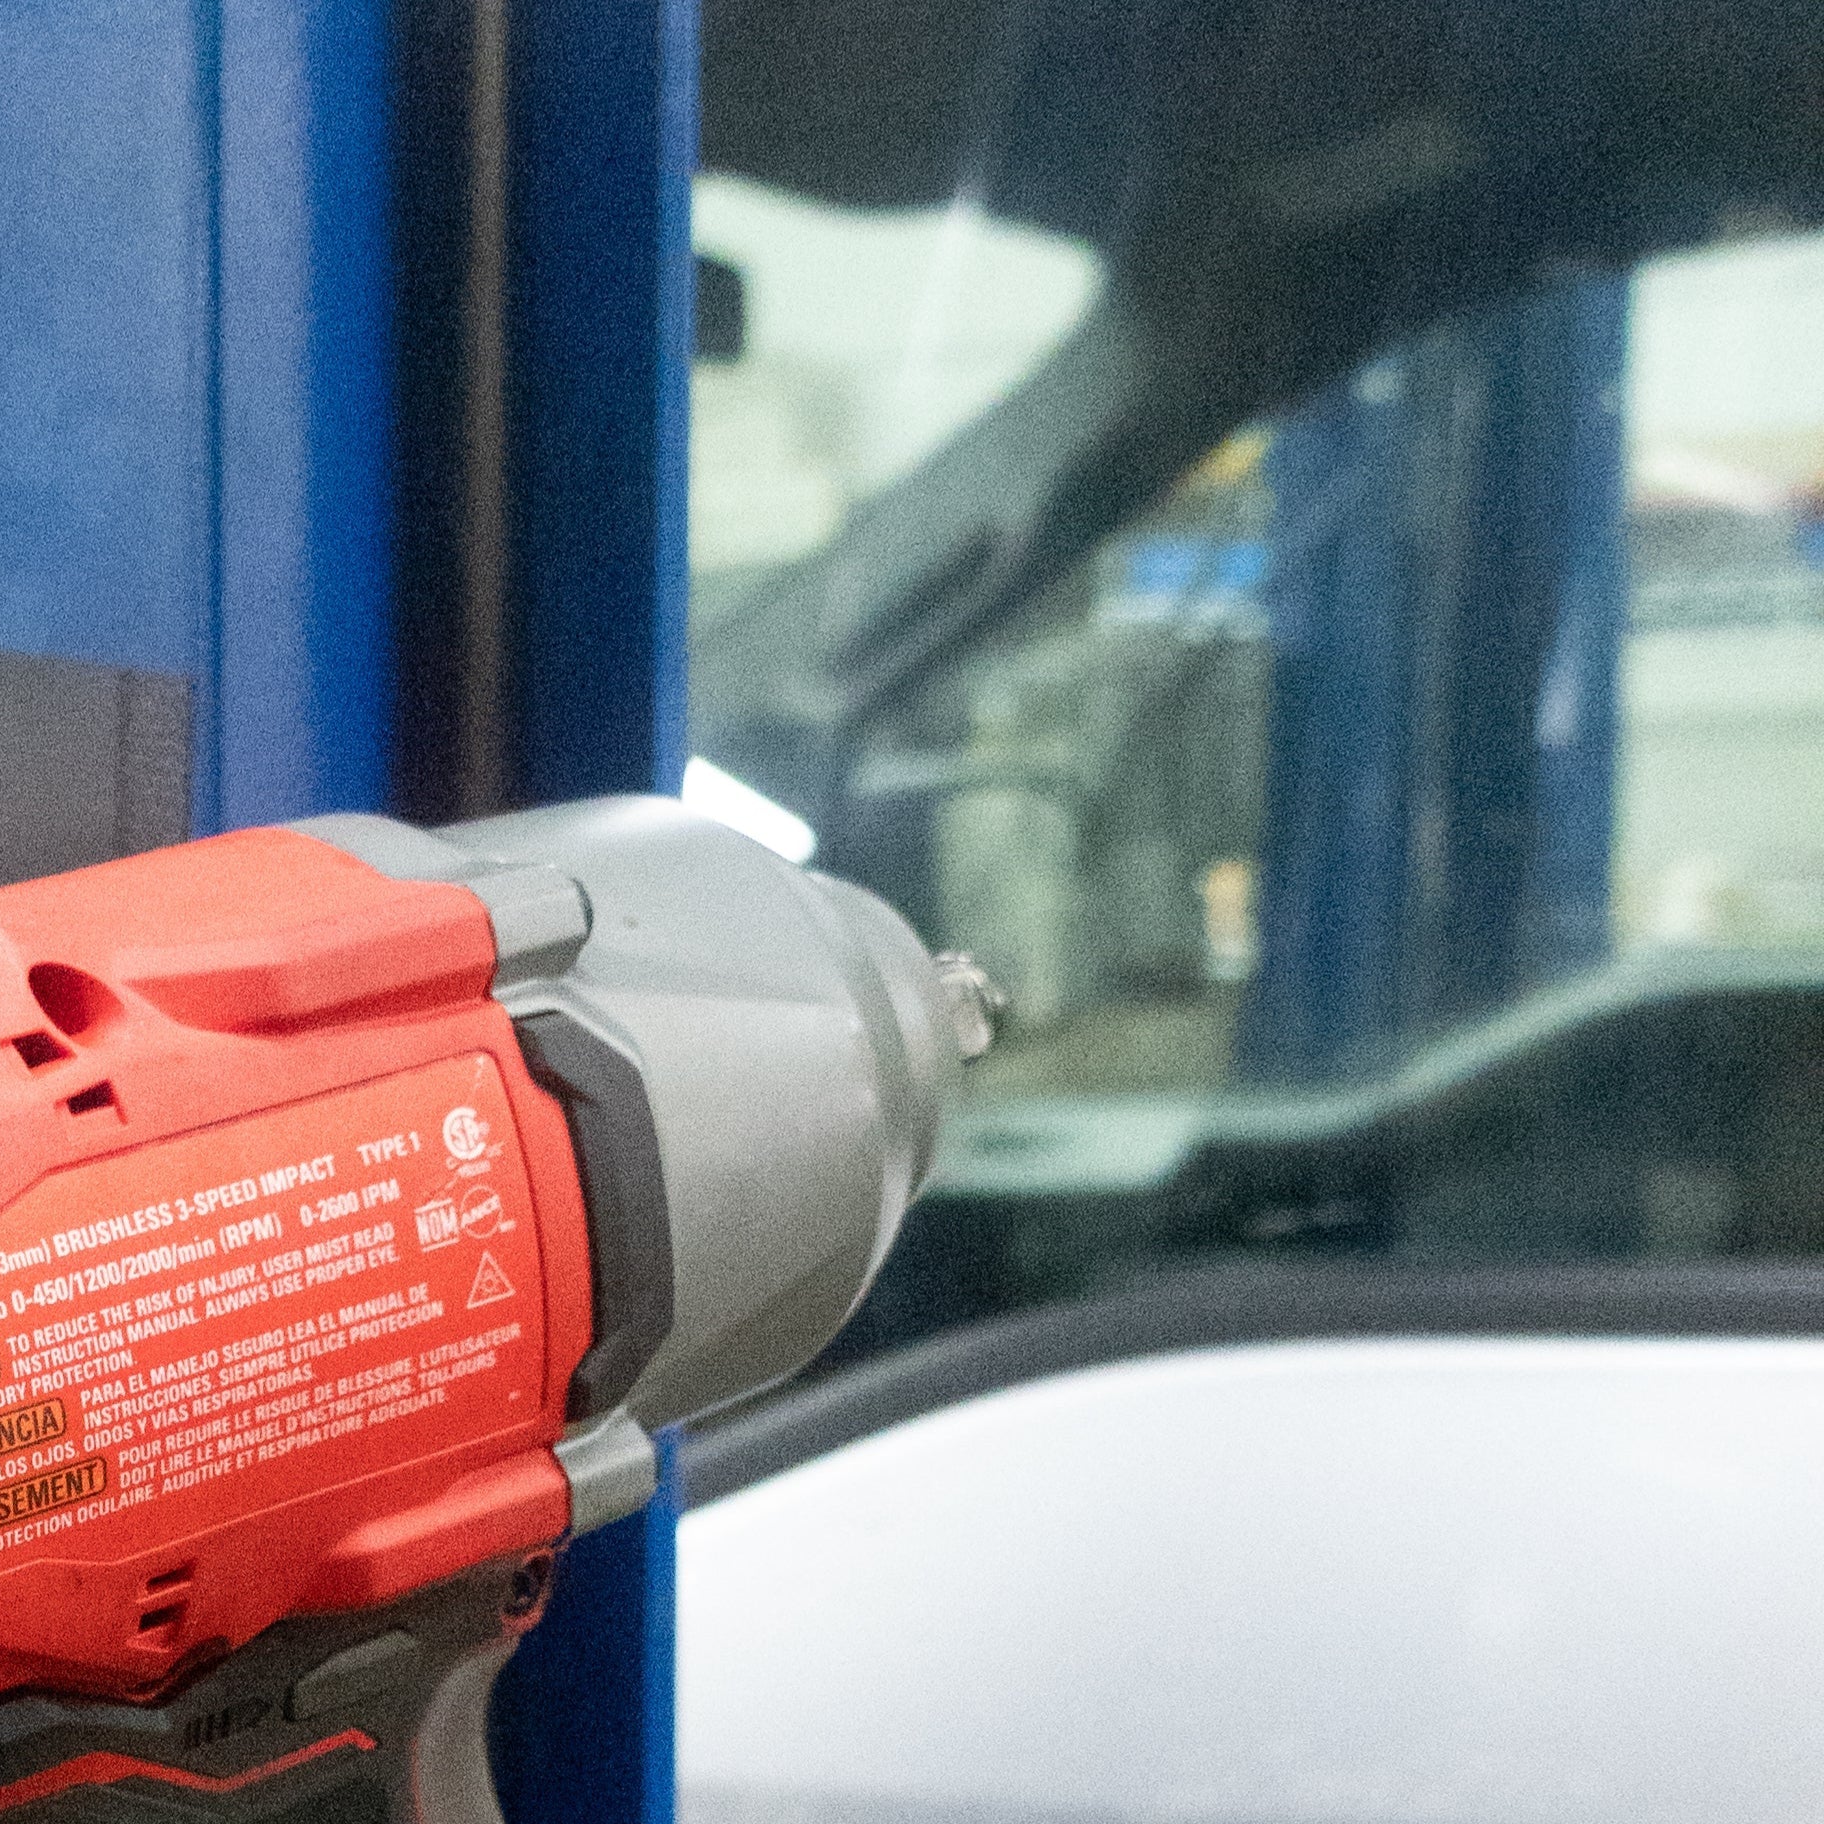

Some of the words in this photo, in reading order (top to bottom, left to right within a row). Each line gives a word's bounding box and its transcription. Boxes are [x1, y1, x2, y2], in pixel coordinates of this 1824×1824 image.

[356, 1133, 407, 1165] TYPE
[408, 1130, 420, 1151] 1
[52, 1202, 173, 1257] BRUSHLESS
[174, 1178, 258, 1221] 3-SPEED
[258, 1155, 334, 1196] IMPACT
[299, 1190, 359, 1226] 0-2600
[361, 1178, 400, 1208] IPM
[416, 1205, 459, 1245] NOM
[5, 1333, 30, 1355] TO
[32, 1312, 98, 1347] REDUCE
[99, 1301, 132, 1326] THE
[134, 1290, 173, 1316] RISK
[175, 1281, 195, 1303] OF
[261, 1250, 303, 1277] USER
[305, 1235, 349, 1263] MUST
[353, 1222, 394, 1248] READ
[11, 1235, 215, 1314] 0-450/1200/2000/min
[218, 1212, 282, 1252] (RPM)
[11, 1328, 124, 1377] INSTRUCTION
[205, 1282, 269, 1318] ALWAYS
[271, 1272, 303, 1297] USE
[304, 1253, 366, 1286] PROPER
[79, 1380, 125, 1408] PARA
[128, 1373, 147, 1393] EL
[149, 1349, 218, 1385] MANEJO
[221, 1328, 285, 1363] SEGURO
[286, 1318, 316, 1342] LEA
[317, 1312, 336, 1332] EL
[338, 1292, 405, 1325] MANUAL
[408, 1282, 428, 1303] DE
[218, 1349, 286, 1386] SIEMPRE
[289, 1330, 346, 1363] UTILICE
[118, 1439, 161, 1467] POUR
[233, 1409, 250, 1429] LE
[254, 1390, 309, 1421] RISQUE
[313, 1382, 333, 1403] DE
[119, 1461, 156, 1488] DOIT
[160, 1449, 192, 1474] LIRE
[196, 1442, 212, 1462] LE
[217, 1421, 282, 1455] MANUEL
[136, 1416, 147, 1433] Y
[161, 1456, 231, 1494] AUDITIVE
[235, 1448, 254, 1469] ET
